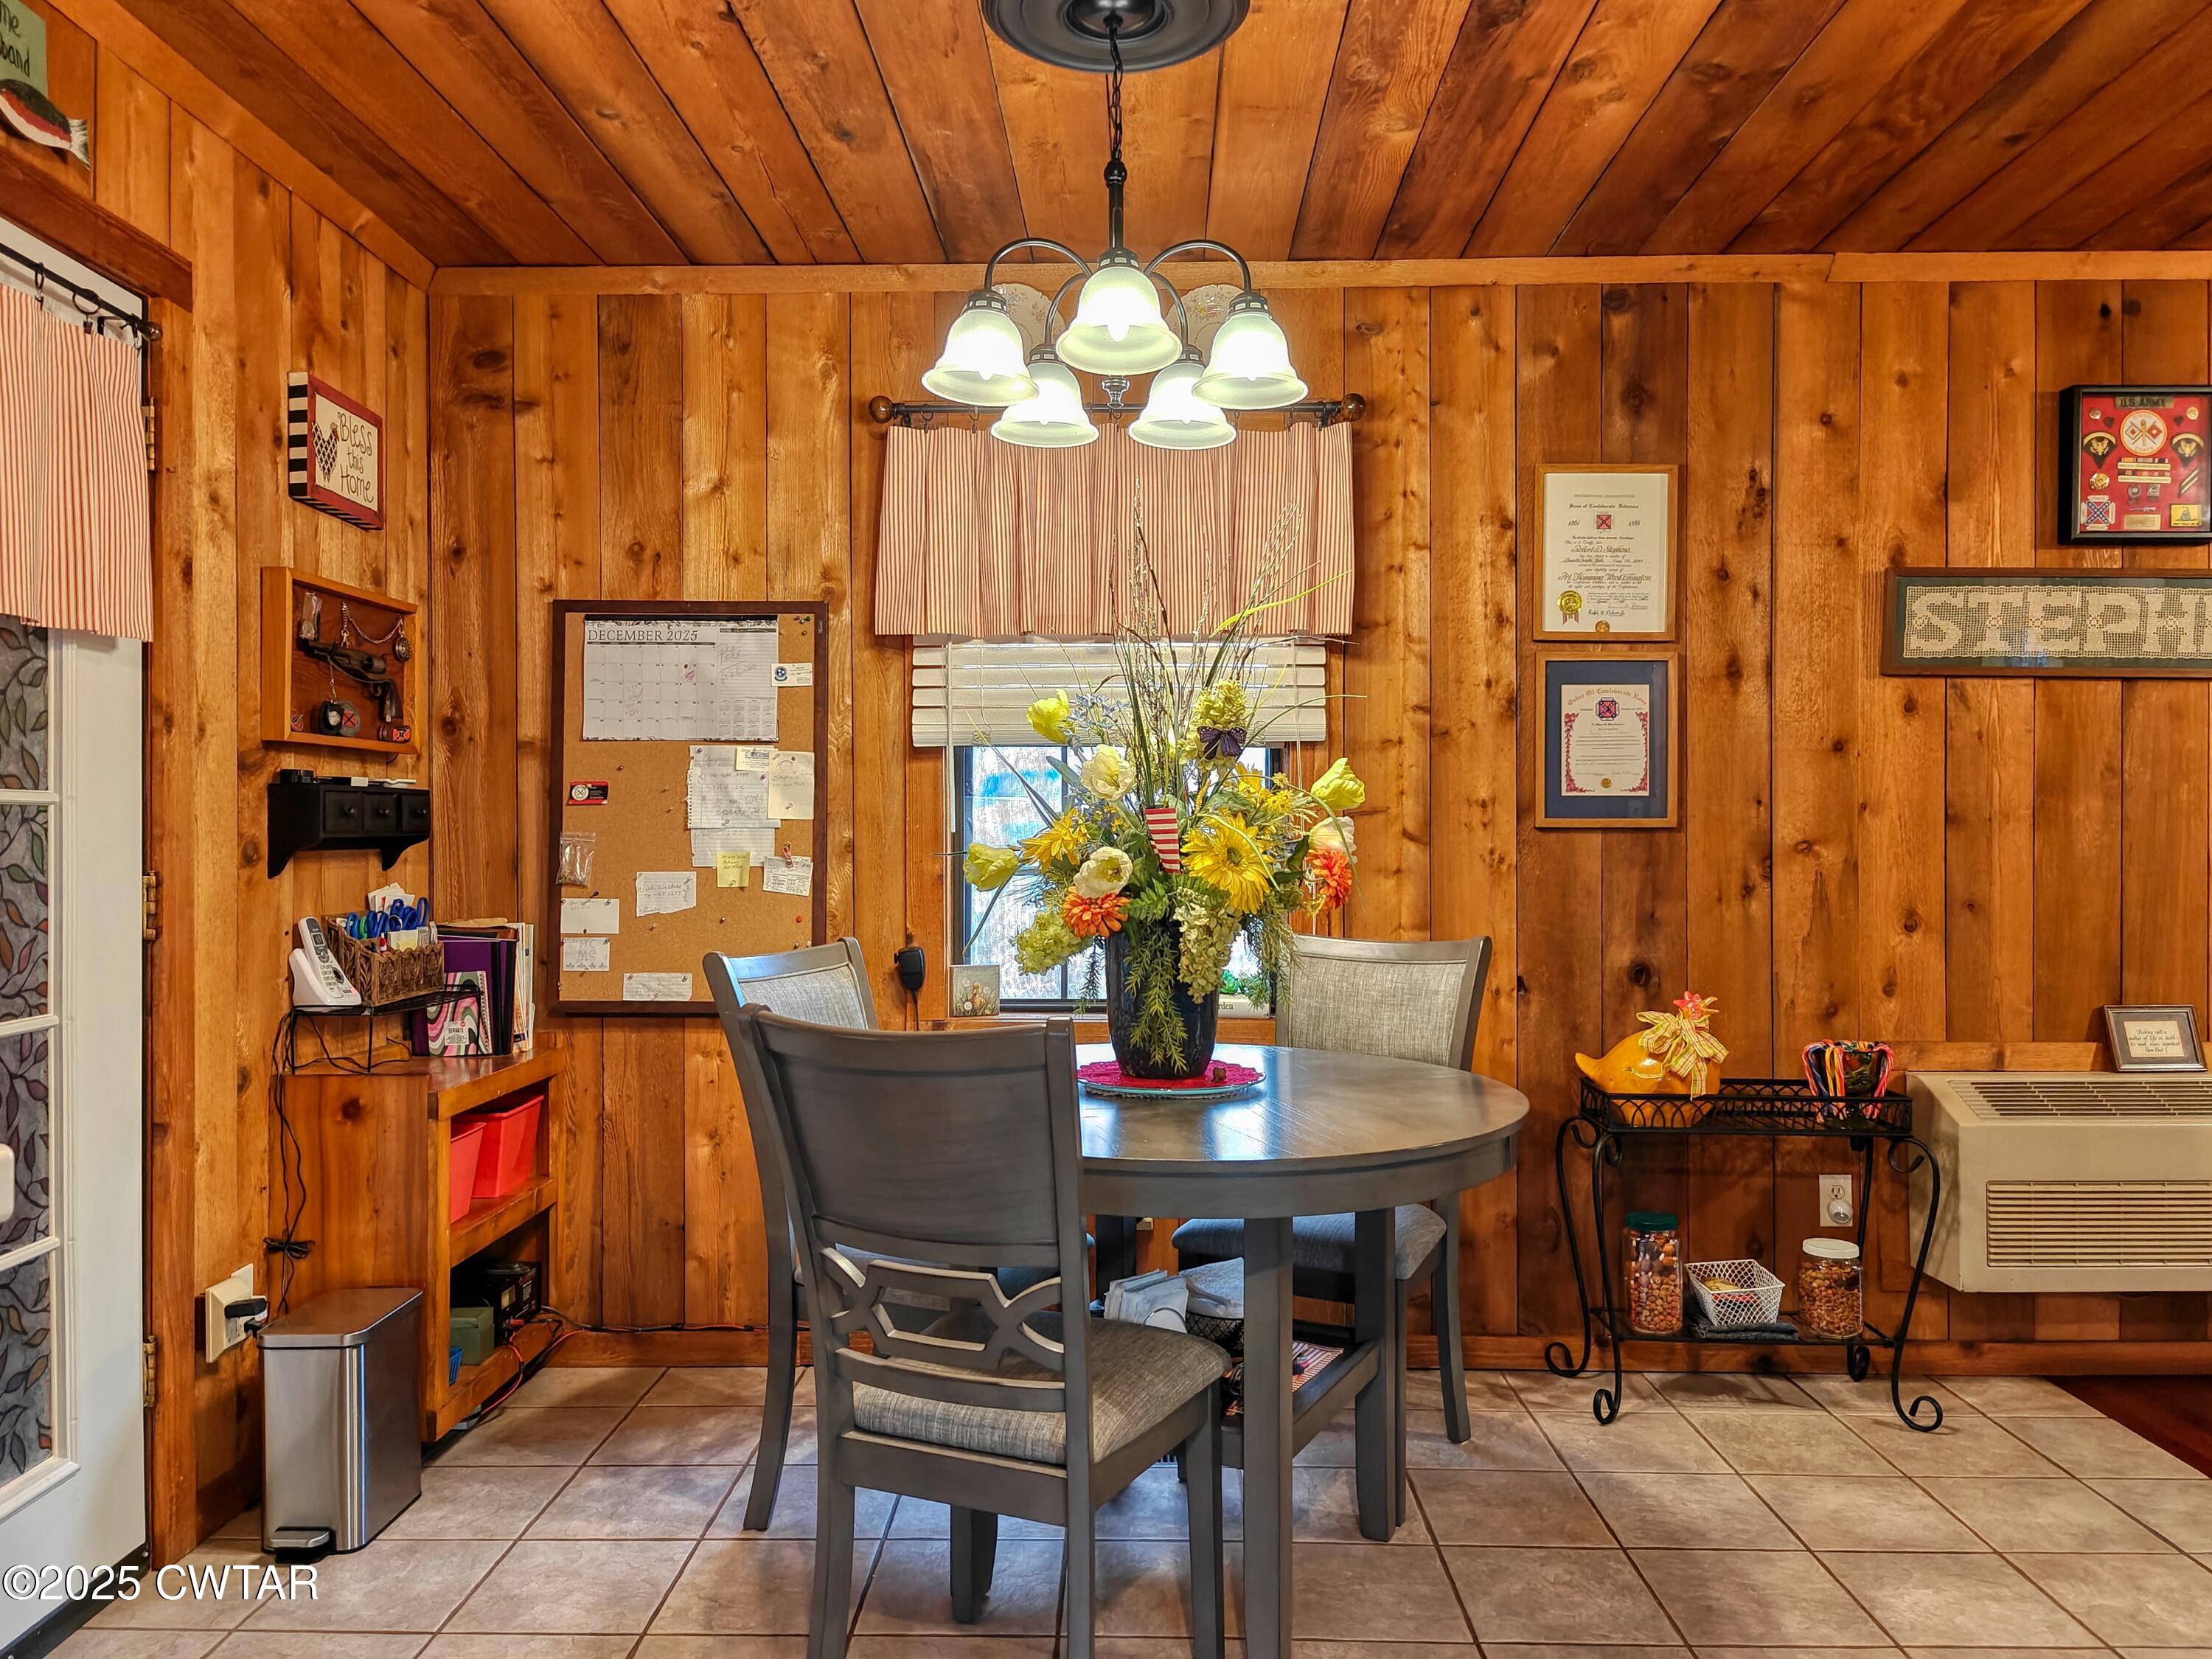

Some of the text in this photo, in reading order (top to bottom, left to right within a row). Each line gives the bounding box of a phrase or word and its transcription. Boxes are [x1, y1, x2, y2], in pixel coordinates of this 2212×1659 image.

[337, 411, 372, 456] Bless
[347, 447, 364, 474] this
[340, 464, 374, 503] Home
[588, 630, 699, 641] DECEMBER 2025
[1912, 592, 2212, 653] STEPH
[1568, 695, 1585, 706] Order
[1596, 687, 1632, 697] Confederate
